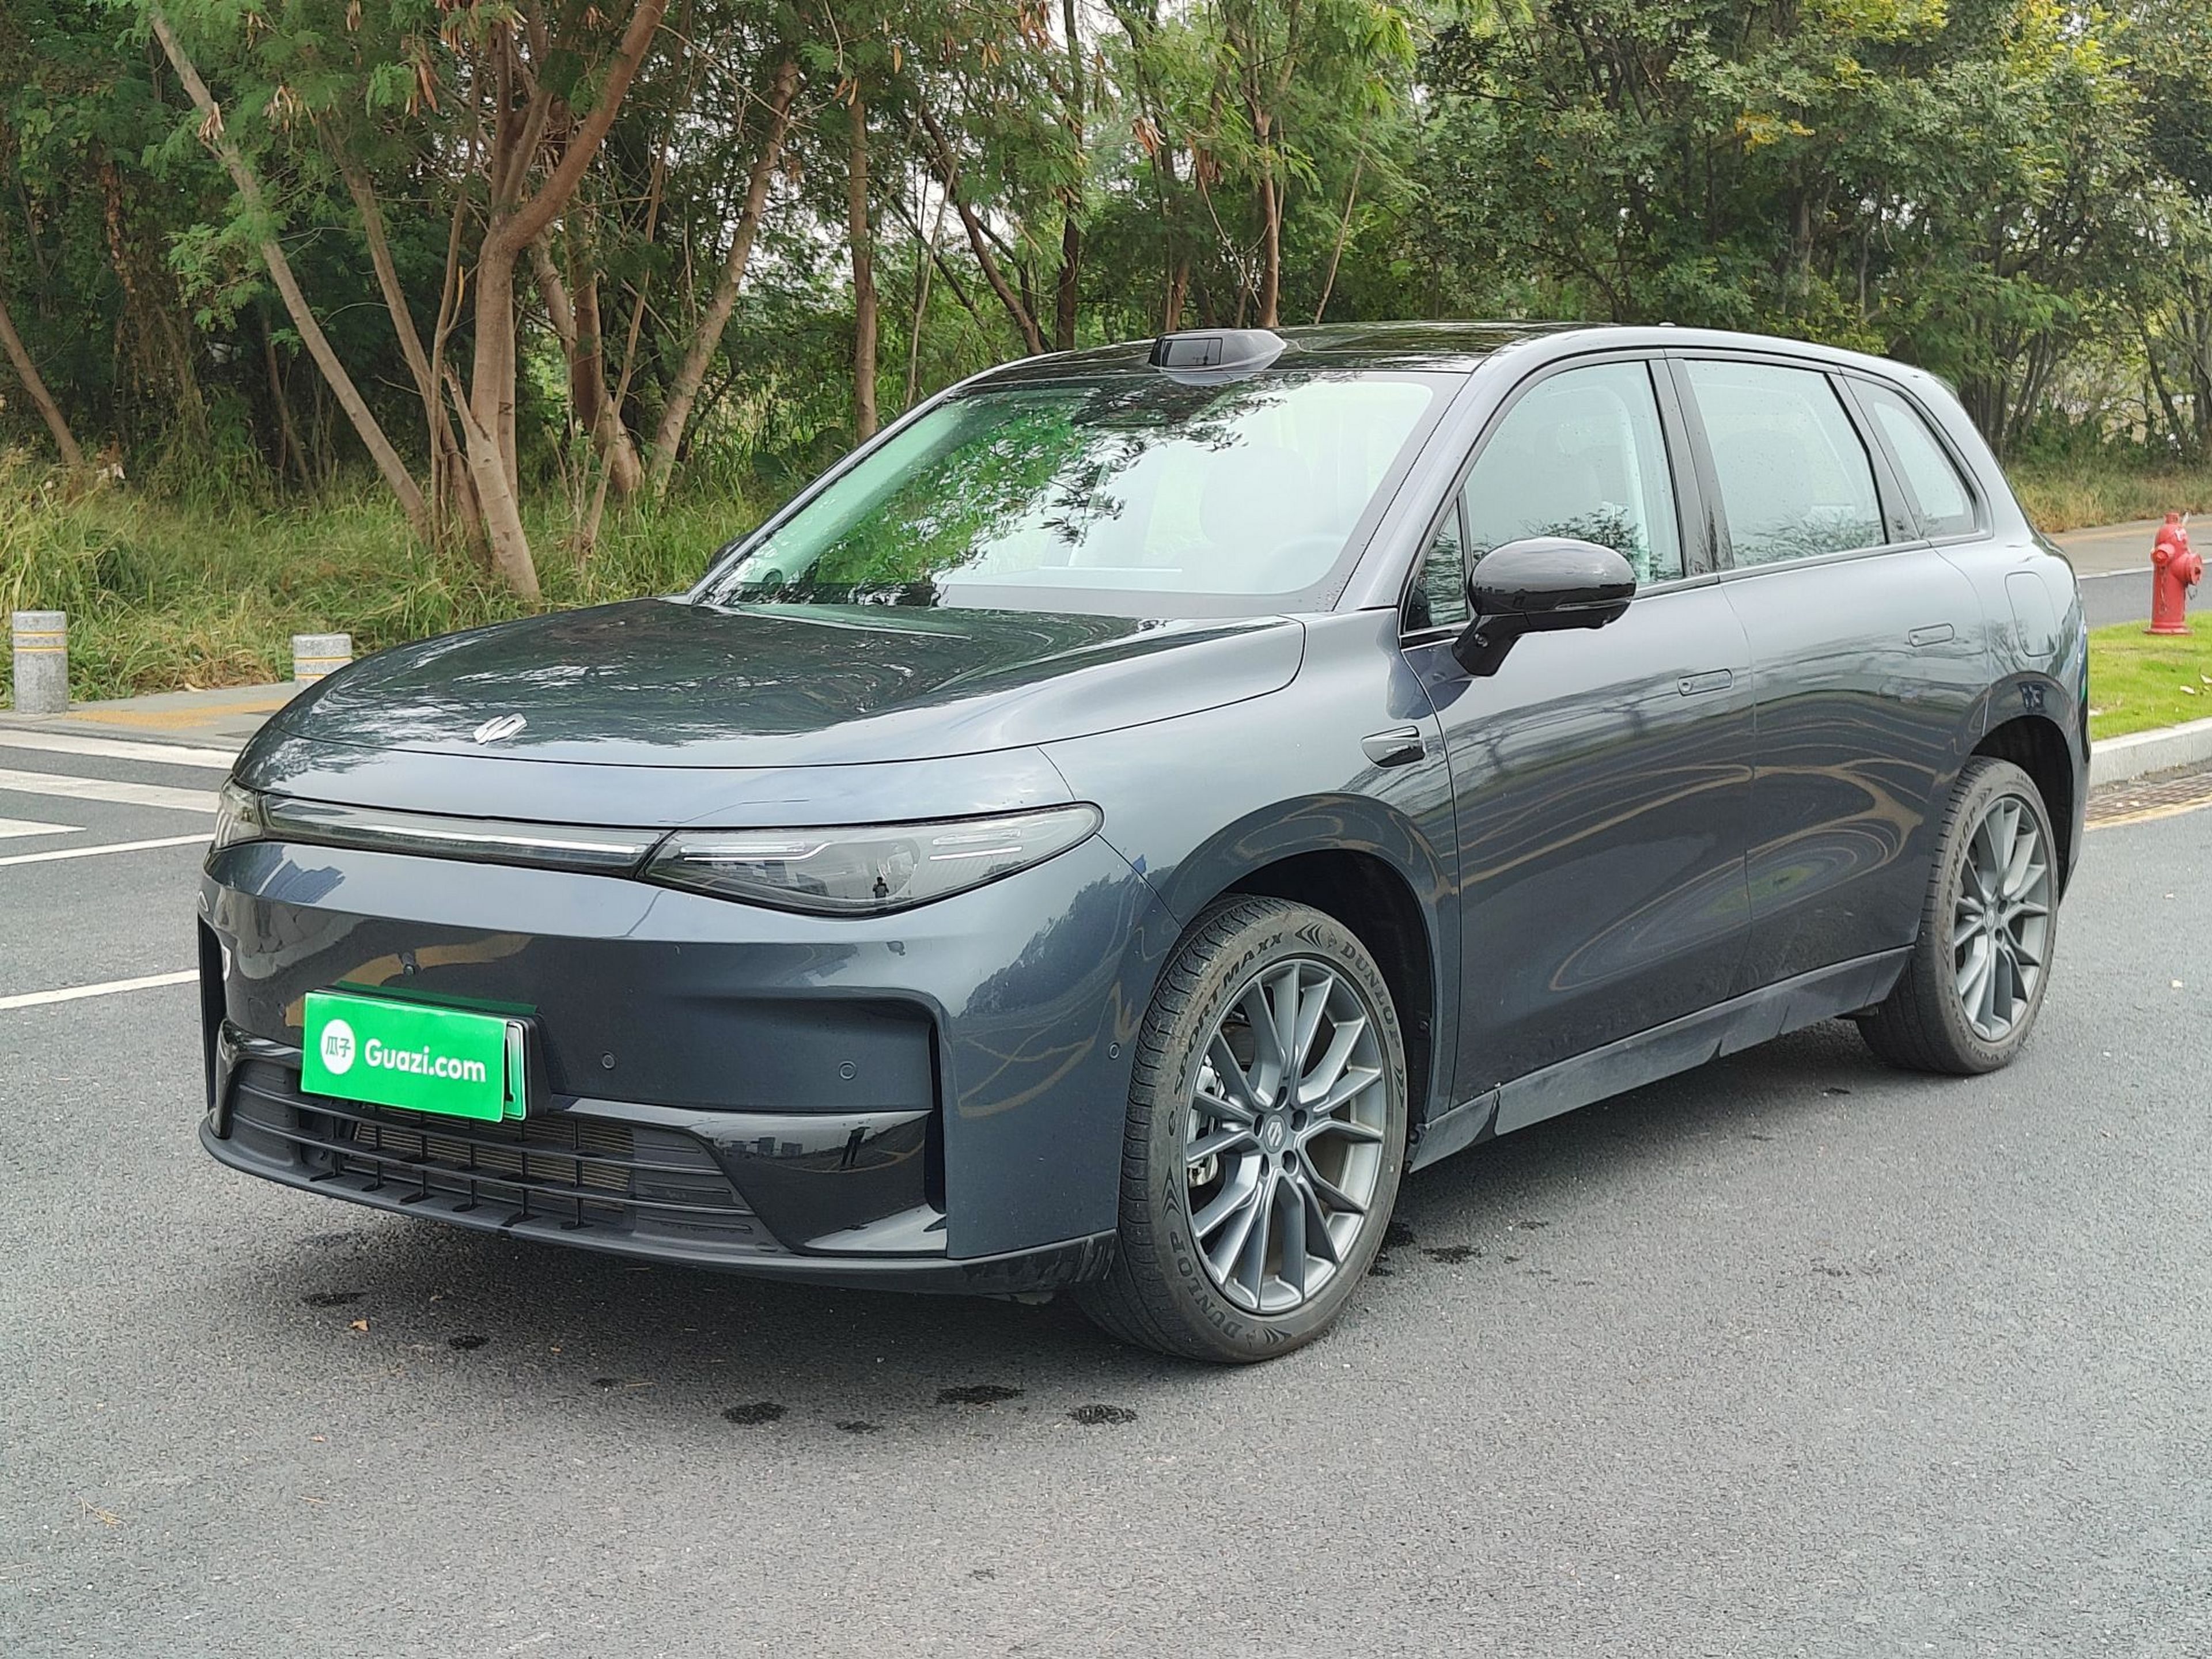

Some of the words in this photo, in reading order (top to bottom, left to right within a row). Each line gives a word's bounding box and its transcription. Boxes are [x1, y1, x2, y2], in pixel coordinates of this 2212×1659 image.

[1223, 933, 1283, 989] MAXX
[1340, 941, 1400, 1049] DUNLOP
[325, 1035, 351, 1058] 瓜子
[365, 1038, 486, 1083] Guazi.com
[1169, 1231, 1243, 1339] DUNLOP
